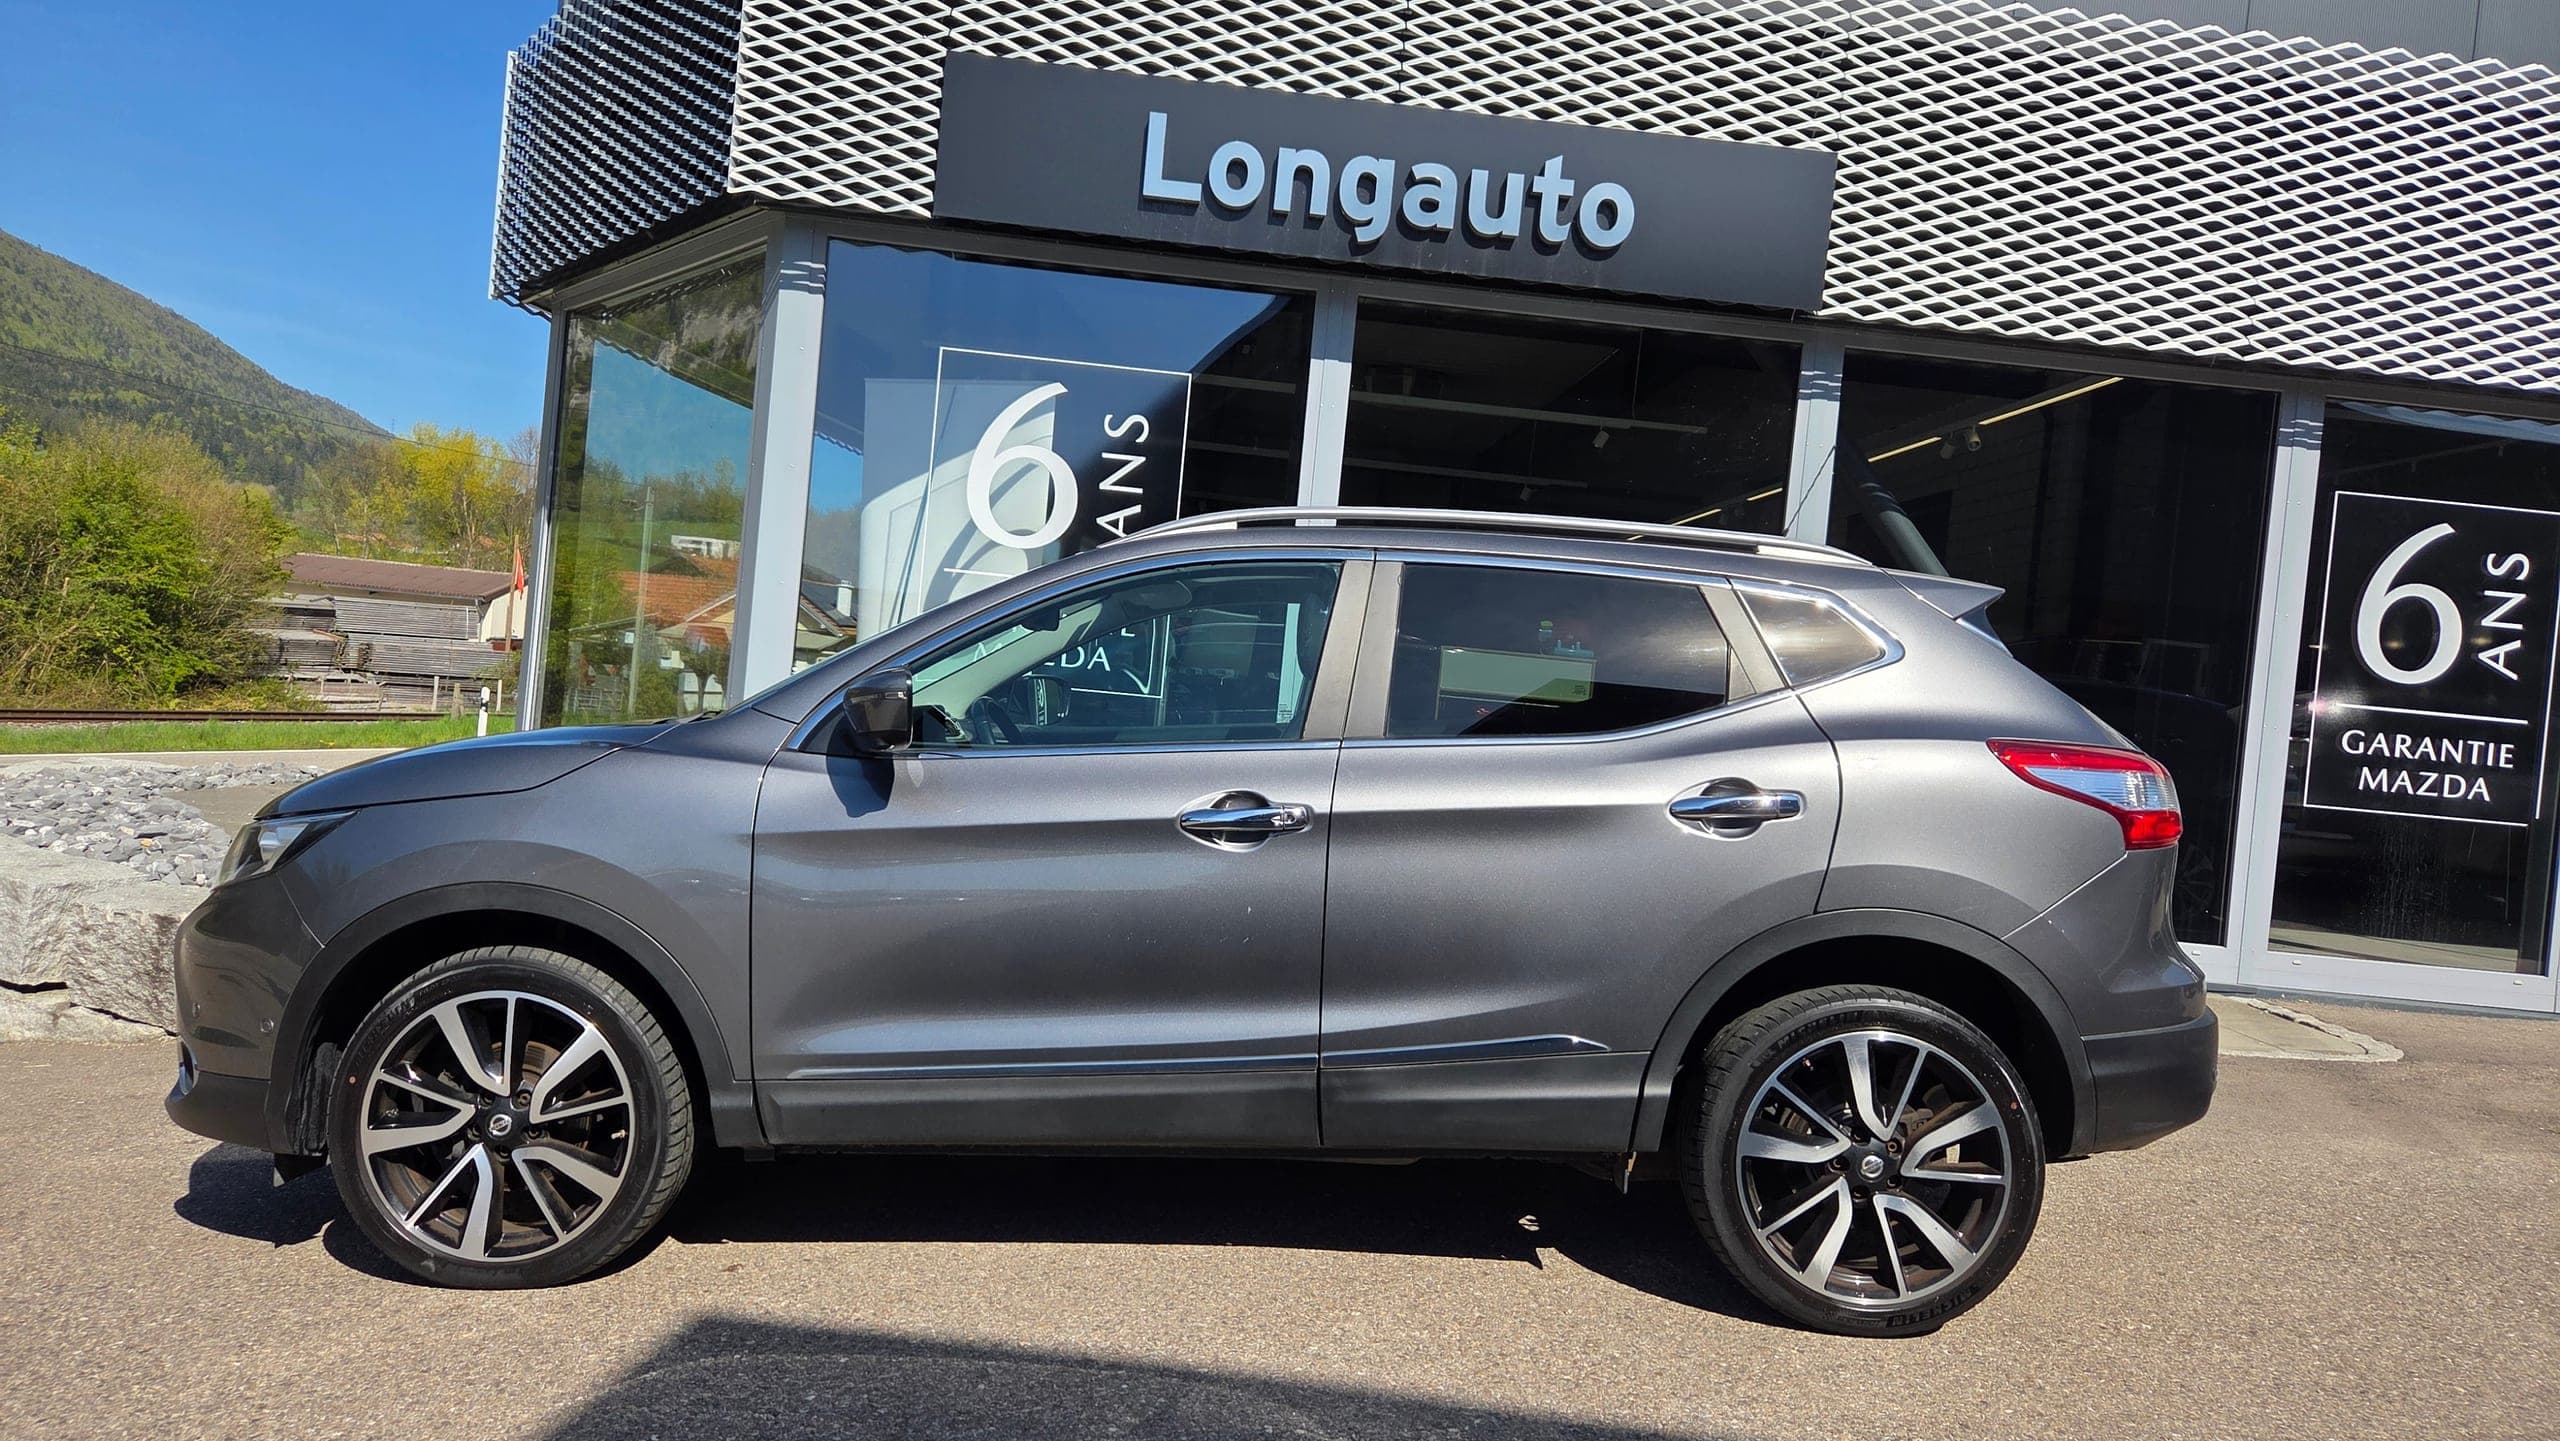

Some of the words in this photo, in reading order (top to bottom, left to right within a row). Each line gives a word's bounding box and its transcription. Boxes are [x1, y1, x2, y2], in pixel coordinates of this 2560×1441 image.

[1142, 111, 1635, 250] Longauto
[967, 381, 1079, 549] 6
[1096, 413, 1150, 540] ANS
[2356, 522, 2463, 685] 6
[2477, 552, 2531, 681] ANS
[2341, 729, 2515, 769] GARANTIE
[2358, 766, 2491, 802] MAZDA
